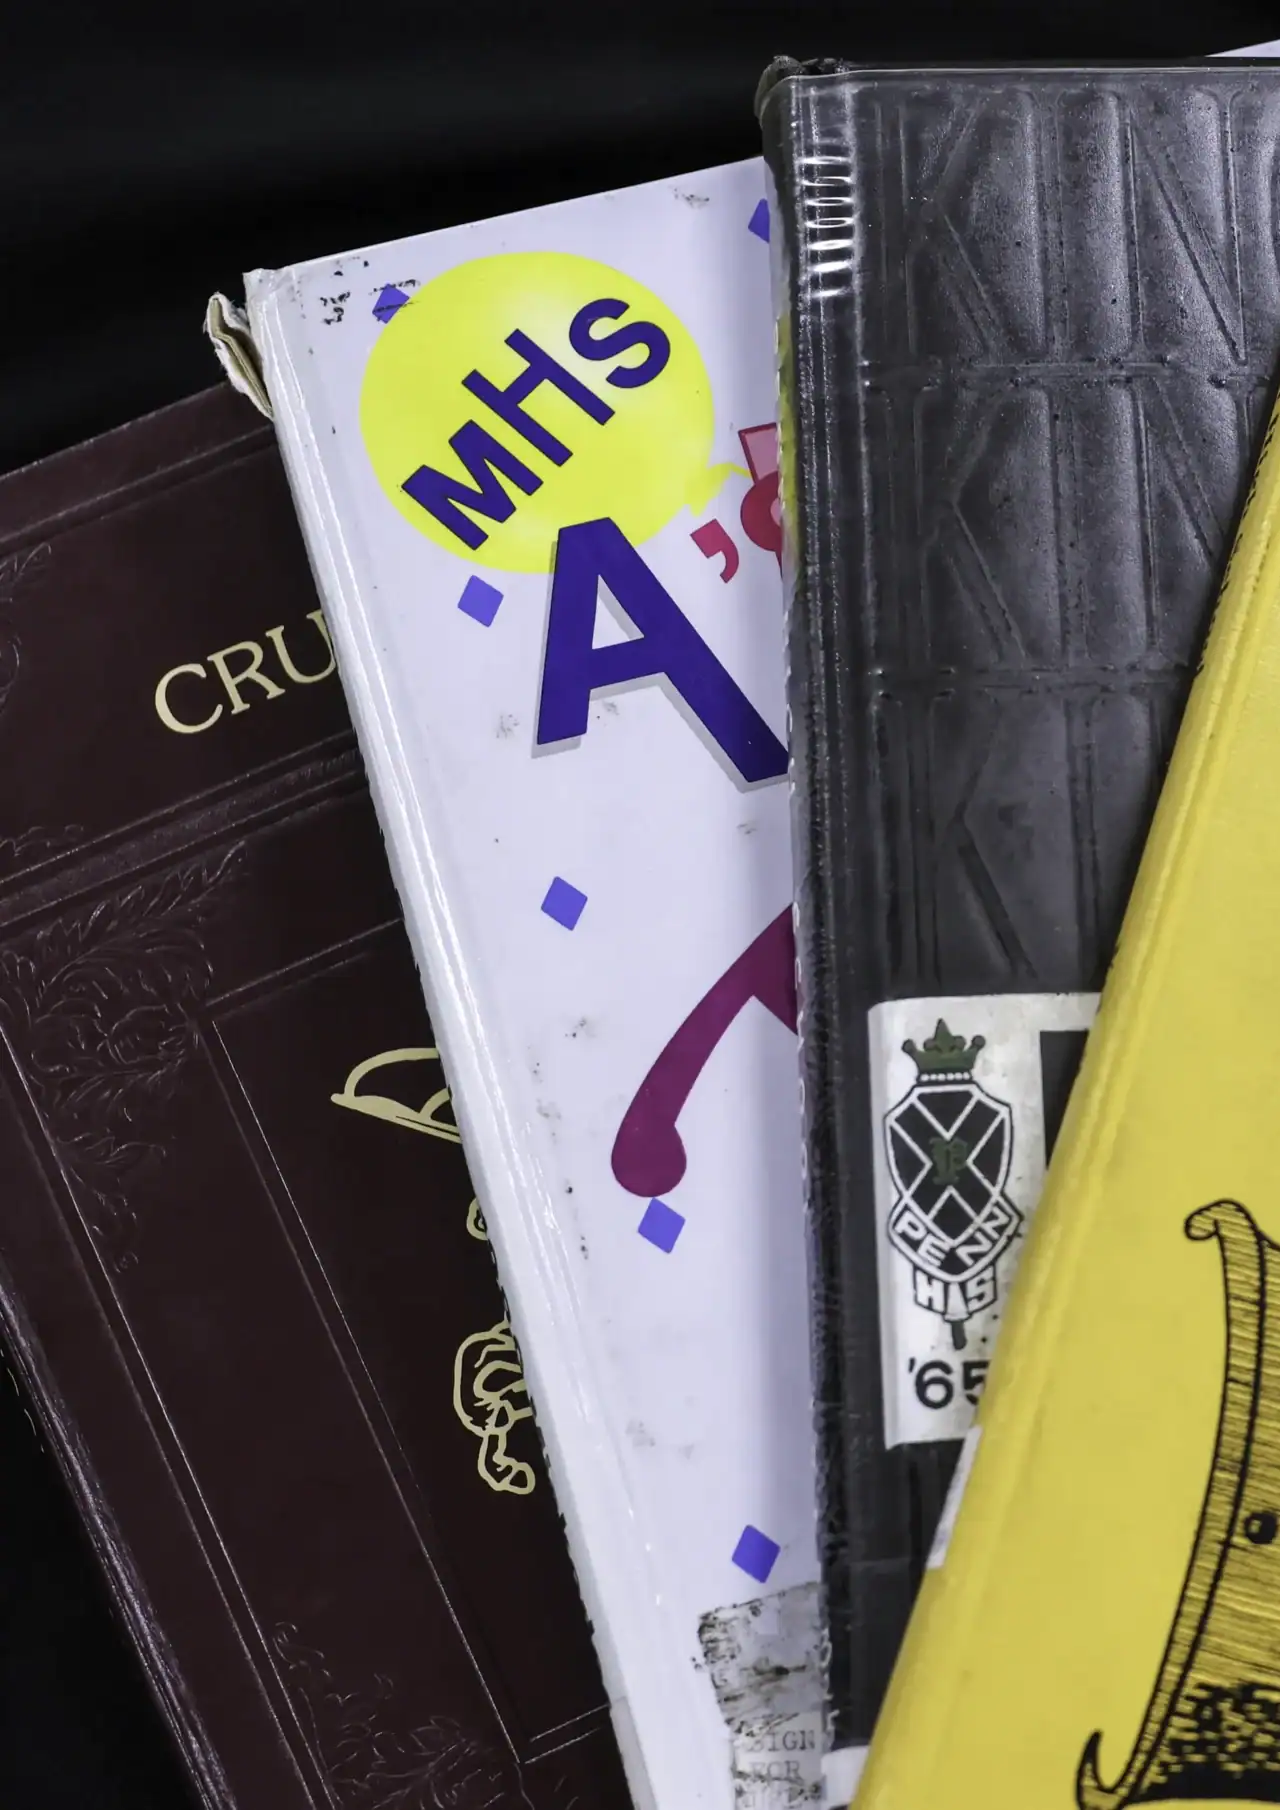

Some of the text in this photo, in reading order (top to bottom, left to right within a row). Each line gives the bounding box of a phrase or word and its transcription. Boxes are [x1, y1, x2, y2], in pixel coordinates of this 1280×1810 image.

[402, 297, 671, 550] MHS
[155, 608, 337, 735] CRU
[537, 517, 789, 783] A
[893, 1198, 1011, 1268] PENN
